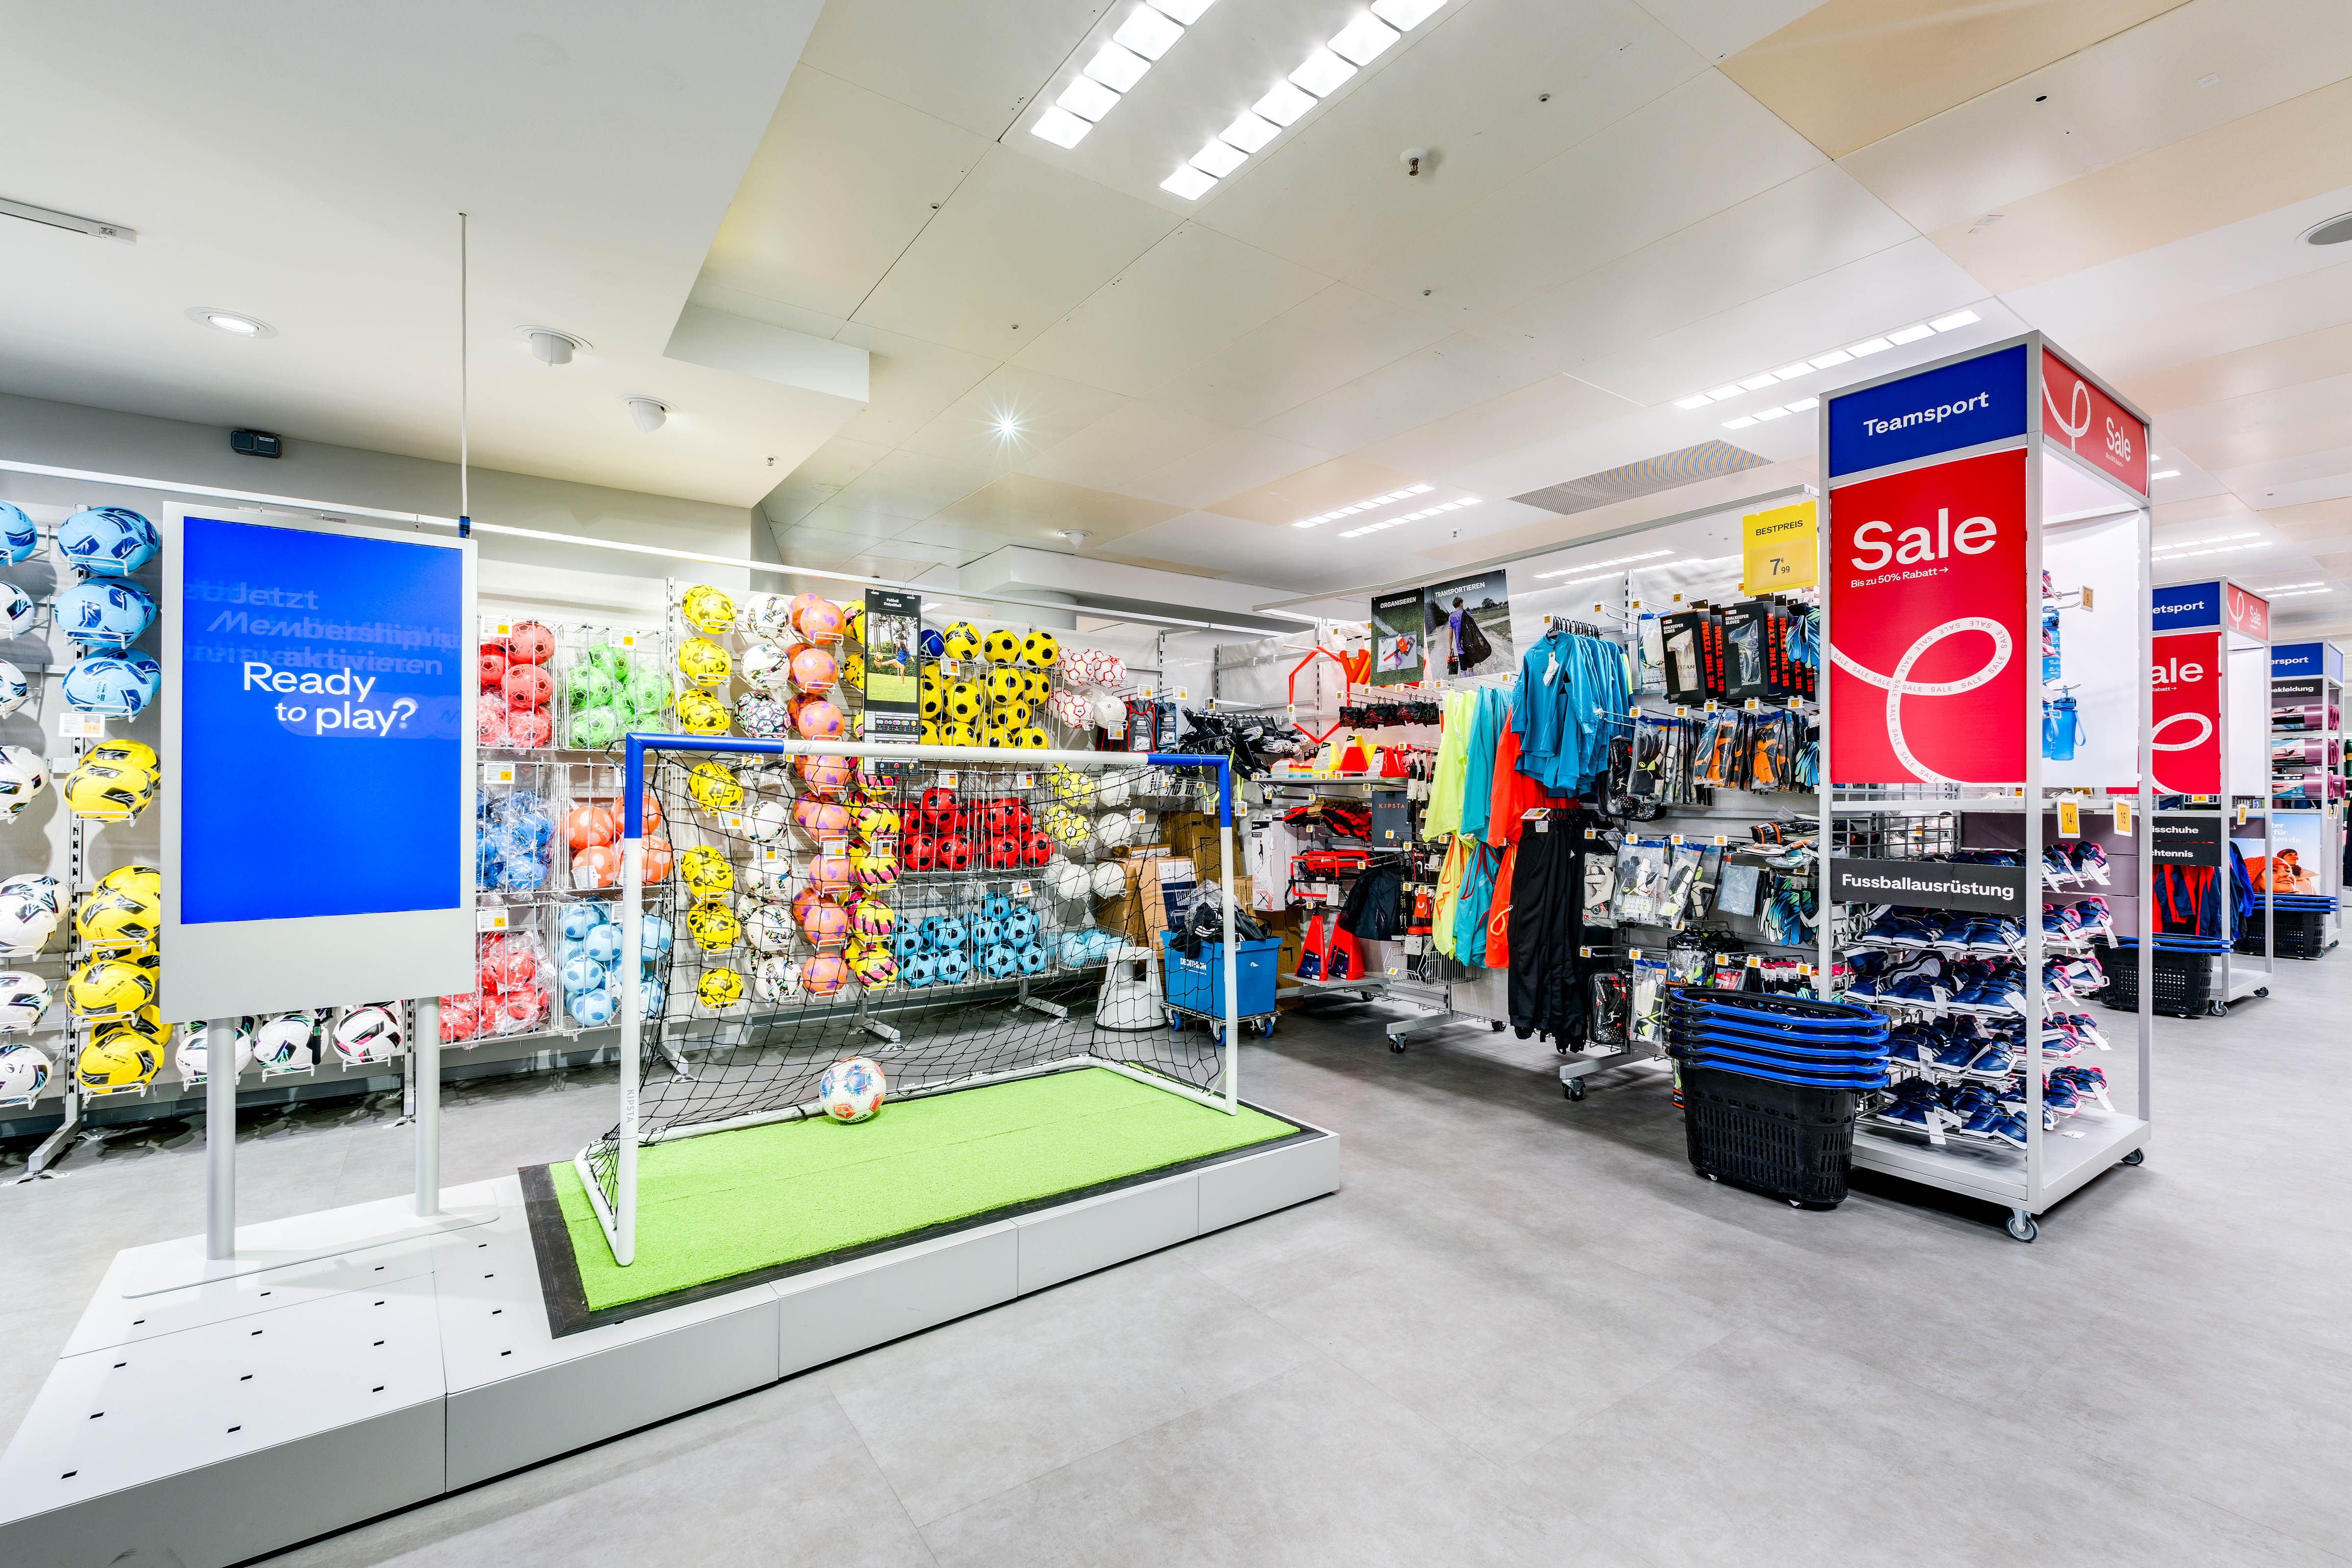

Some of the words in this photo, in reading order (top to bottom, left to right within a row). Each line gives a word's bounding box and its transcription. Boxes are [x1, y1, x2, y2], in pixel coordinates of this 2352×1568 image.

[1863, 392, 1989, 436] Teamsport
[2106, 416, 2131, 462] Sale
[1756, 520, 1803, 536] BESTPREIS
[1851, 508, 1997, 570] Sale
[1770, 558, 1781, 575] 7
[1851, 578, 1864, 588] Bis
[1878, 573, 1901, 584] 50%
[1902, 568, 1937, 580] Rabatt
[1435, 582, 1485, 598] TRANSPORTIEREN
[1380, 596, 1417, 609] ORGANISIEREN
[2152, 601, 2205, 613] etsport
[2250, 605, 2261, 626] Sale
[1938, 623, 1960, 635] SALE
[1914, 636, 1933, 651] SALE
[1995, 630, 2008, 649] SALE
[1705, 654, 1714, 673] THE
[1834, 653, 1849, 666] SALE
[1899, 655, 1912, 673] SALE
[1988, 655, 2006, 674] SALE
[2271, 656, 2309, 665] ersport
[1771, 669, 1778, 683] BE
[1852, 667, 1869, 678] SALE
[2152, 657, 2204, 684] ale
[244, 662, 376, 702] Ready
[1707, 674, 1715, 688] BE
[1718, 678, 1724, 692] BE
[1782, 672, 1789, 686] BE
[1795, 676, 1802, 689] BE
[1807, 679, 1813, 692] BE
[1872, 676, 1891, 686] SALE
[1961, 676, 1983, 688] SALE
[1891, 680, 1901, 697] SALE
[274, 703, 307, 721] to
[316, 700, 416, 736] play?
[1892, 729, 1902, 746] SALE
[1900, 751, 1916, 767] SALE
[1919, 770, 1938, 783] SALE
[2152, 825, 2199, 834] isschuhe
[1842, 874, 2014, 901] Fussballausrüstung
[1180, 957, 1206, 970] DECATHLON
